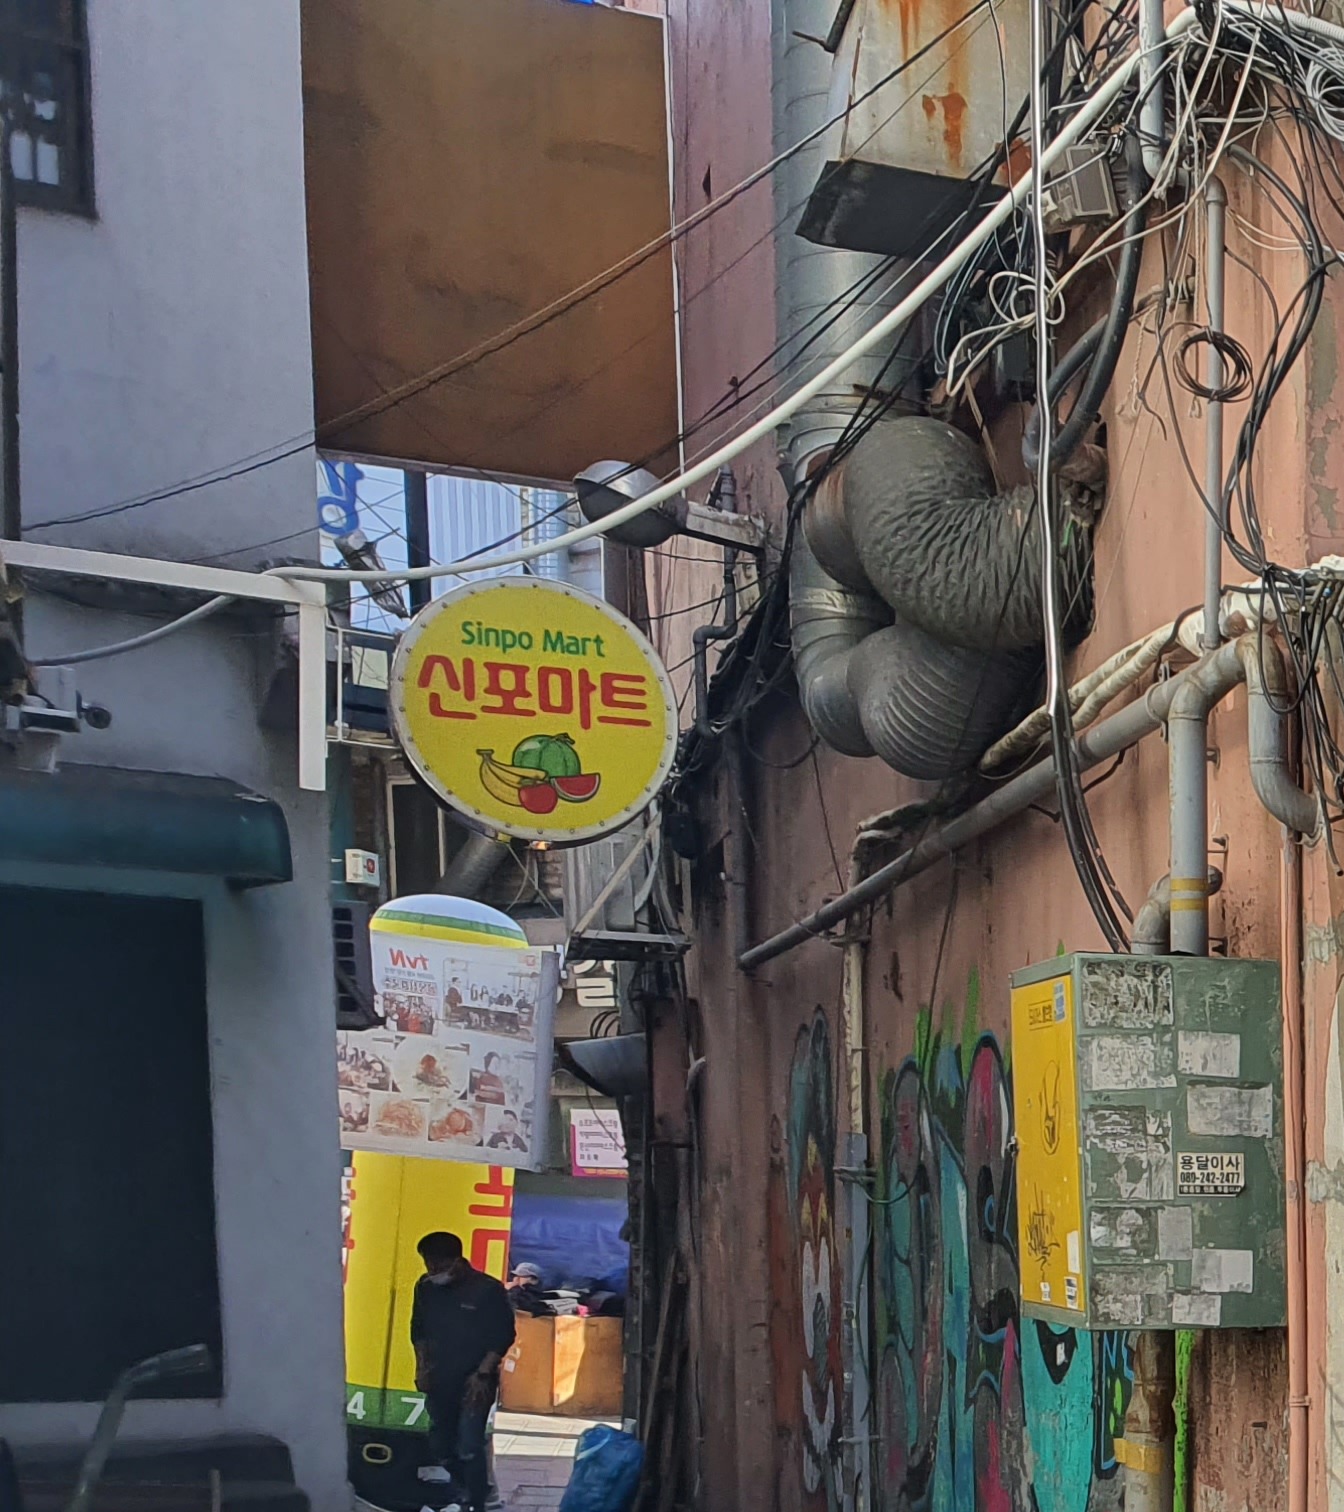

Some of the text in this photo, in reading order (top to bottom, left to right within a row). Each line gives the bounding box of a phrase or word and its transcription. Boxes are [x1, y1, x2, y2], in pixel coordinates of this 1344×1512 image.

[461, 620, 606, 657] Sinpo Mart
[418, 654, 652, 730] 신포마트
[1180, 1155, 1241, 1171] 용달이사
[346, 1391, 425, 1426] 4 7
